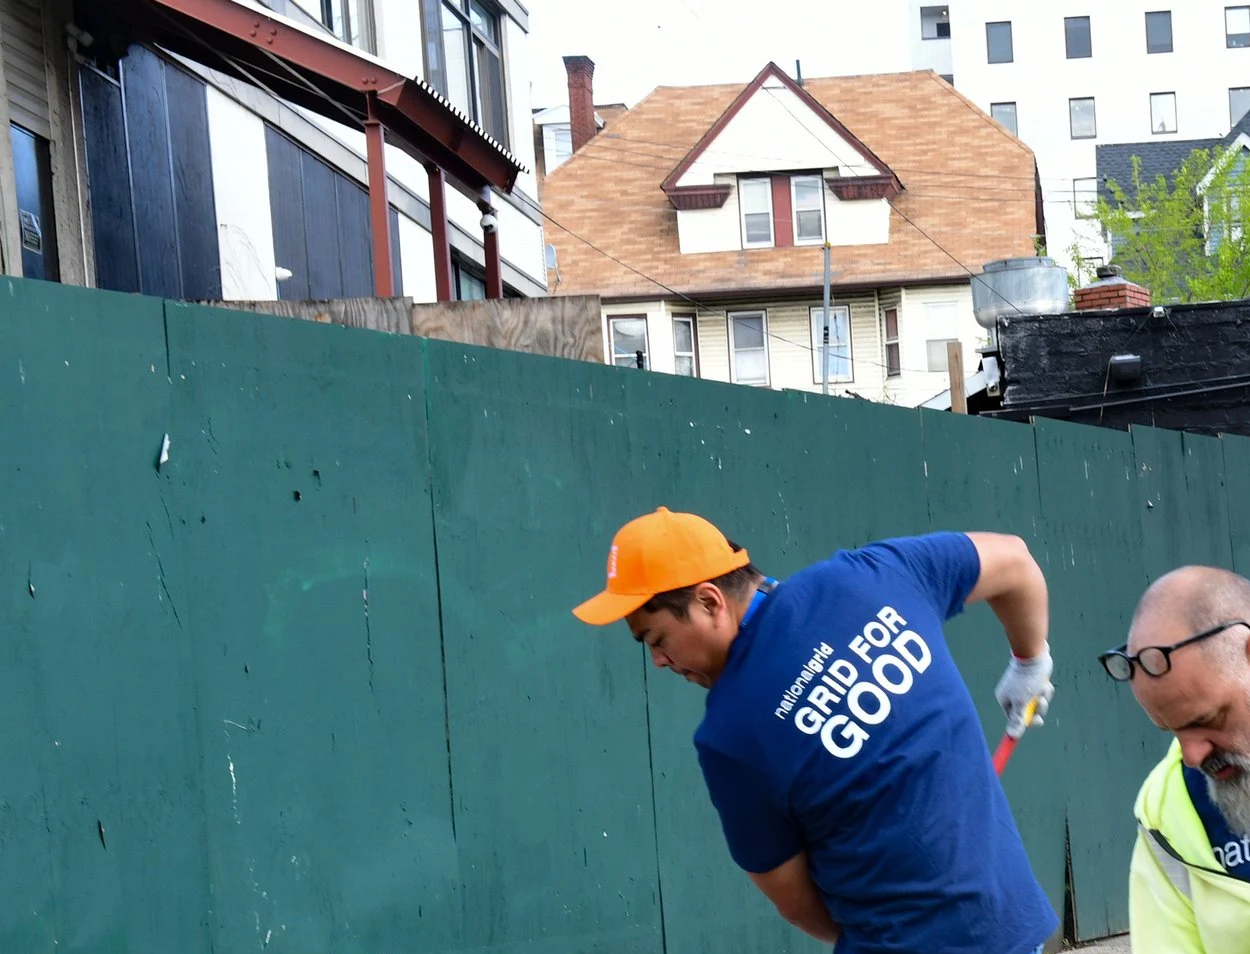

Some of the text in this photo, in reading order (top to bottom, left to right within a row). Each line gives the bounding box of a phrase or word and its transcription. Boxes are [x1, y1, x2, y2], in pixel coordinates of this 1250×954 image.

[774, 641, 835, 720] nationalgrid
[794, 605, 908, 735] GRID FOR
[820, 629, 932, 759] GOOD
